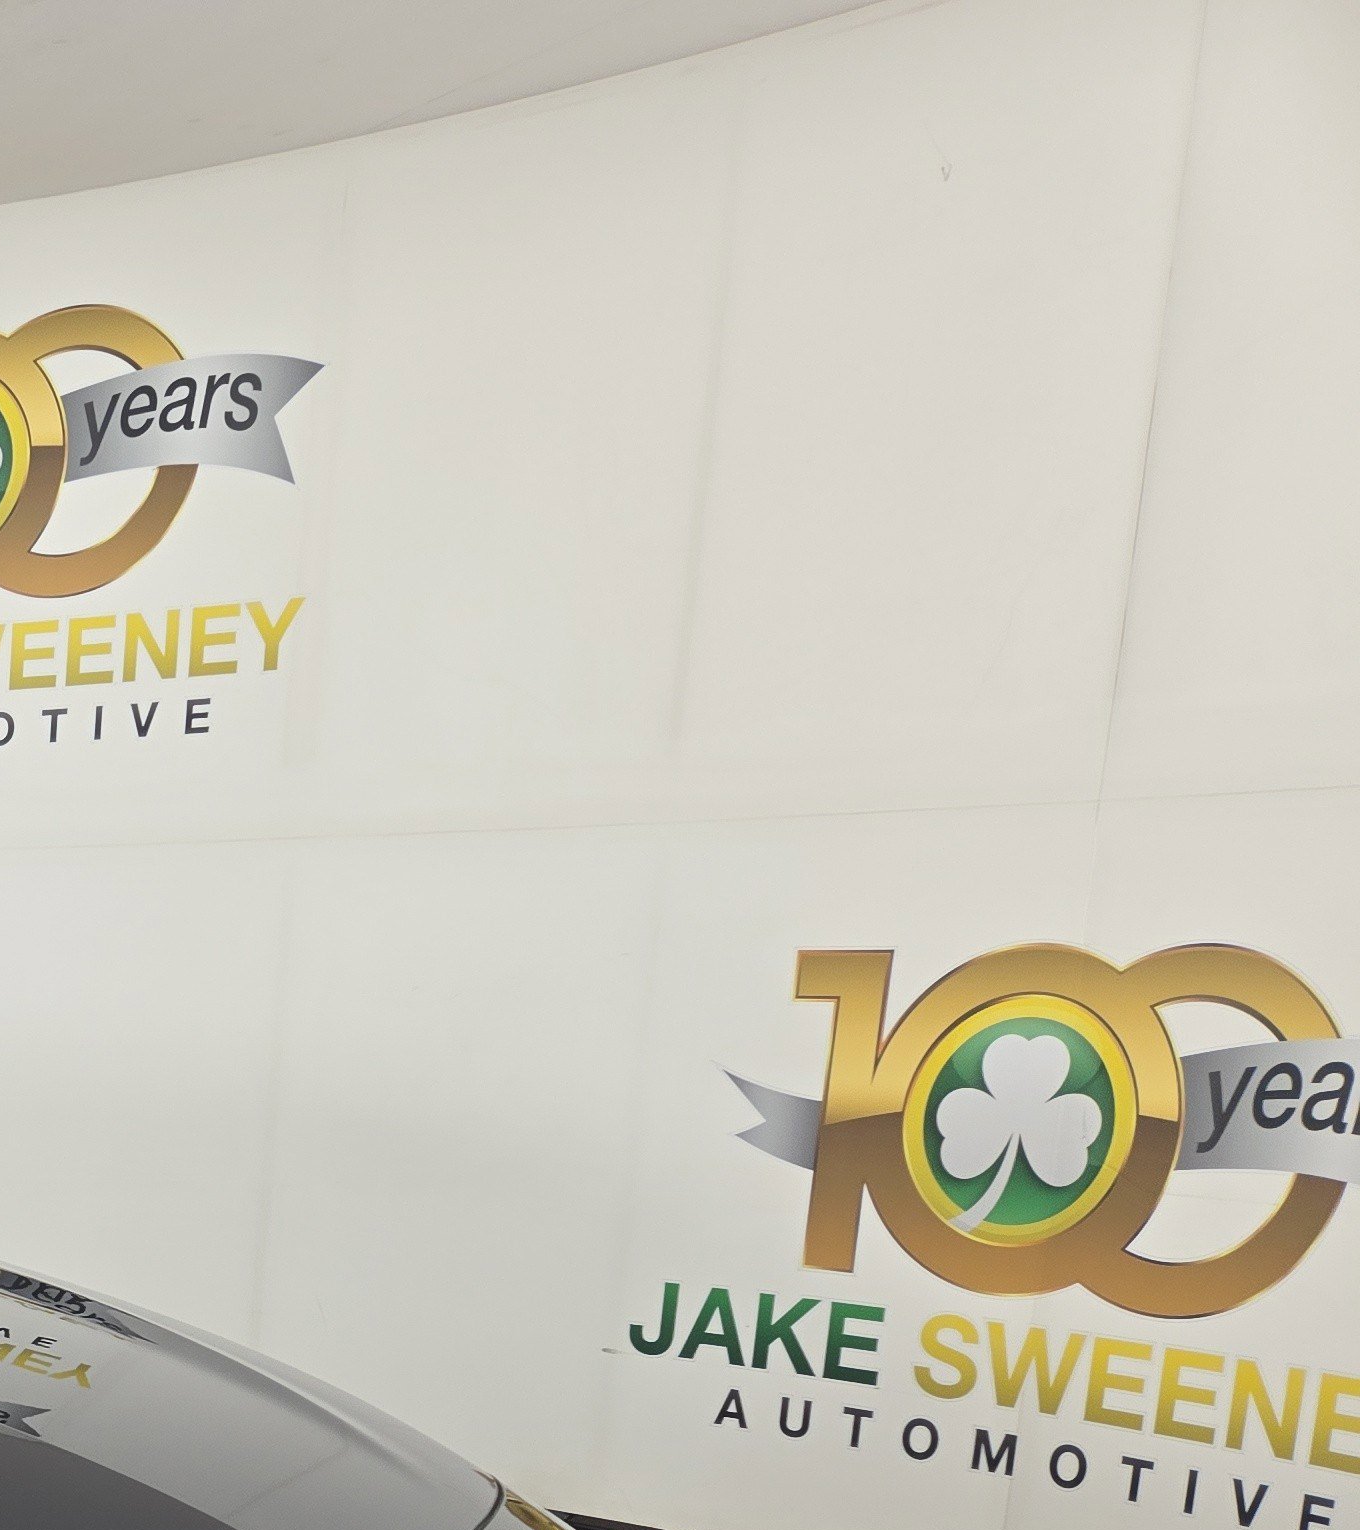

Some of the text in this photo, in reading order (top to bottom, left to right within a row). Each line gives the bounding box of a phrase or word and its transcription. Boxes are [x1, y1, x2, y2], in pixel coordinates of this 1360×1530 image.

[81, 369, 263, 466] years
[1197, 1060, 1360, 1154] yea
[628, 1281, 1360, 1475] JAKE SWEENE
